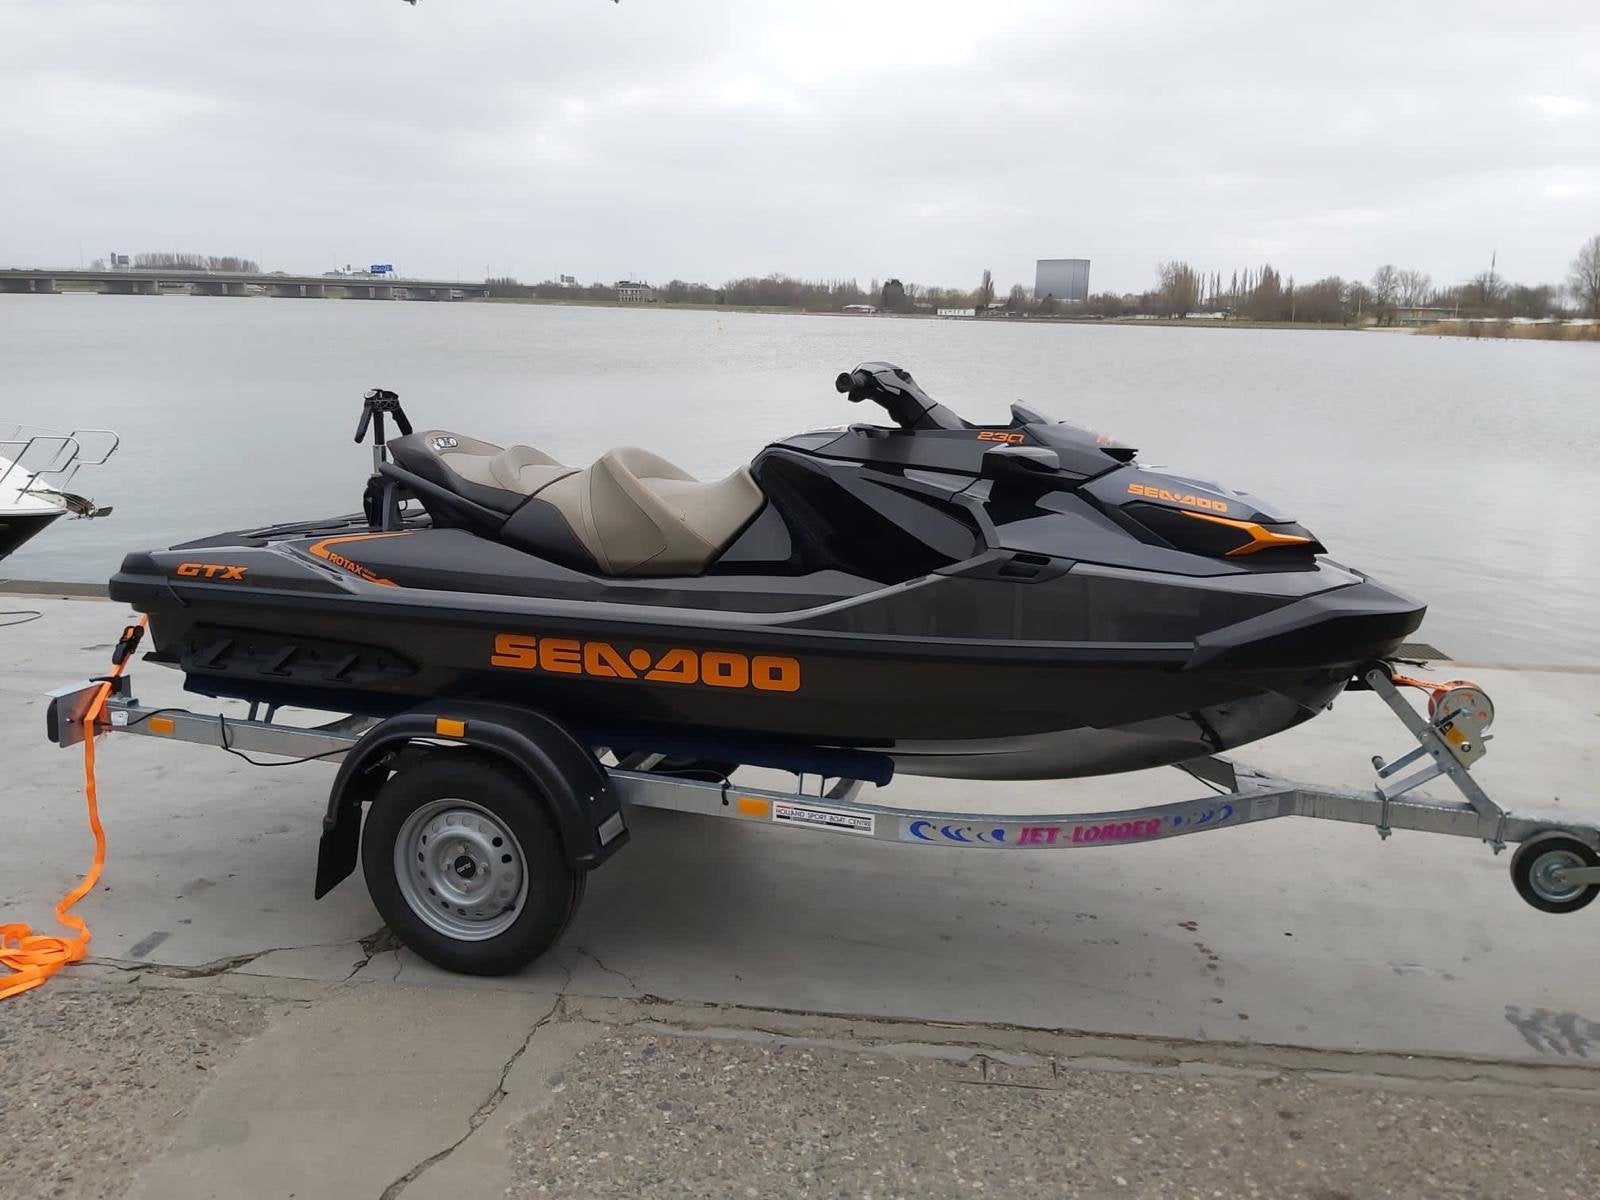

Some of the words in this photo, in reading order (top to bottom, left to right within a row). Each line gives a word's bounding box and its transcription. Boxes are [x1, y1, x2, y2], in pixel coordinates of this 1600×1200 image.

[976, 431, 1025, 443] 230
[177, 563, 249, 580] GTX
[328, 552, 362, 575] ROTAX
[775, 808, 805, 818] HOLLAND
[807, 812, 827, 821] SPORT
[829, 815, 846, 823] BOAT
[848, 818, 872, 828] CENTRE
